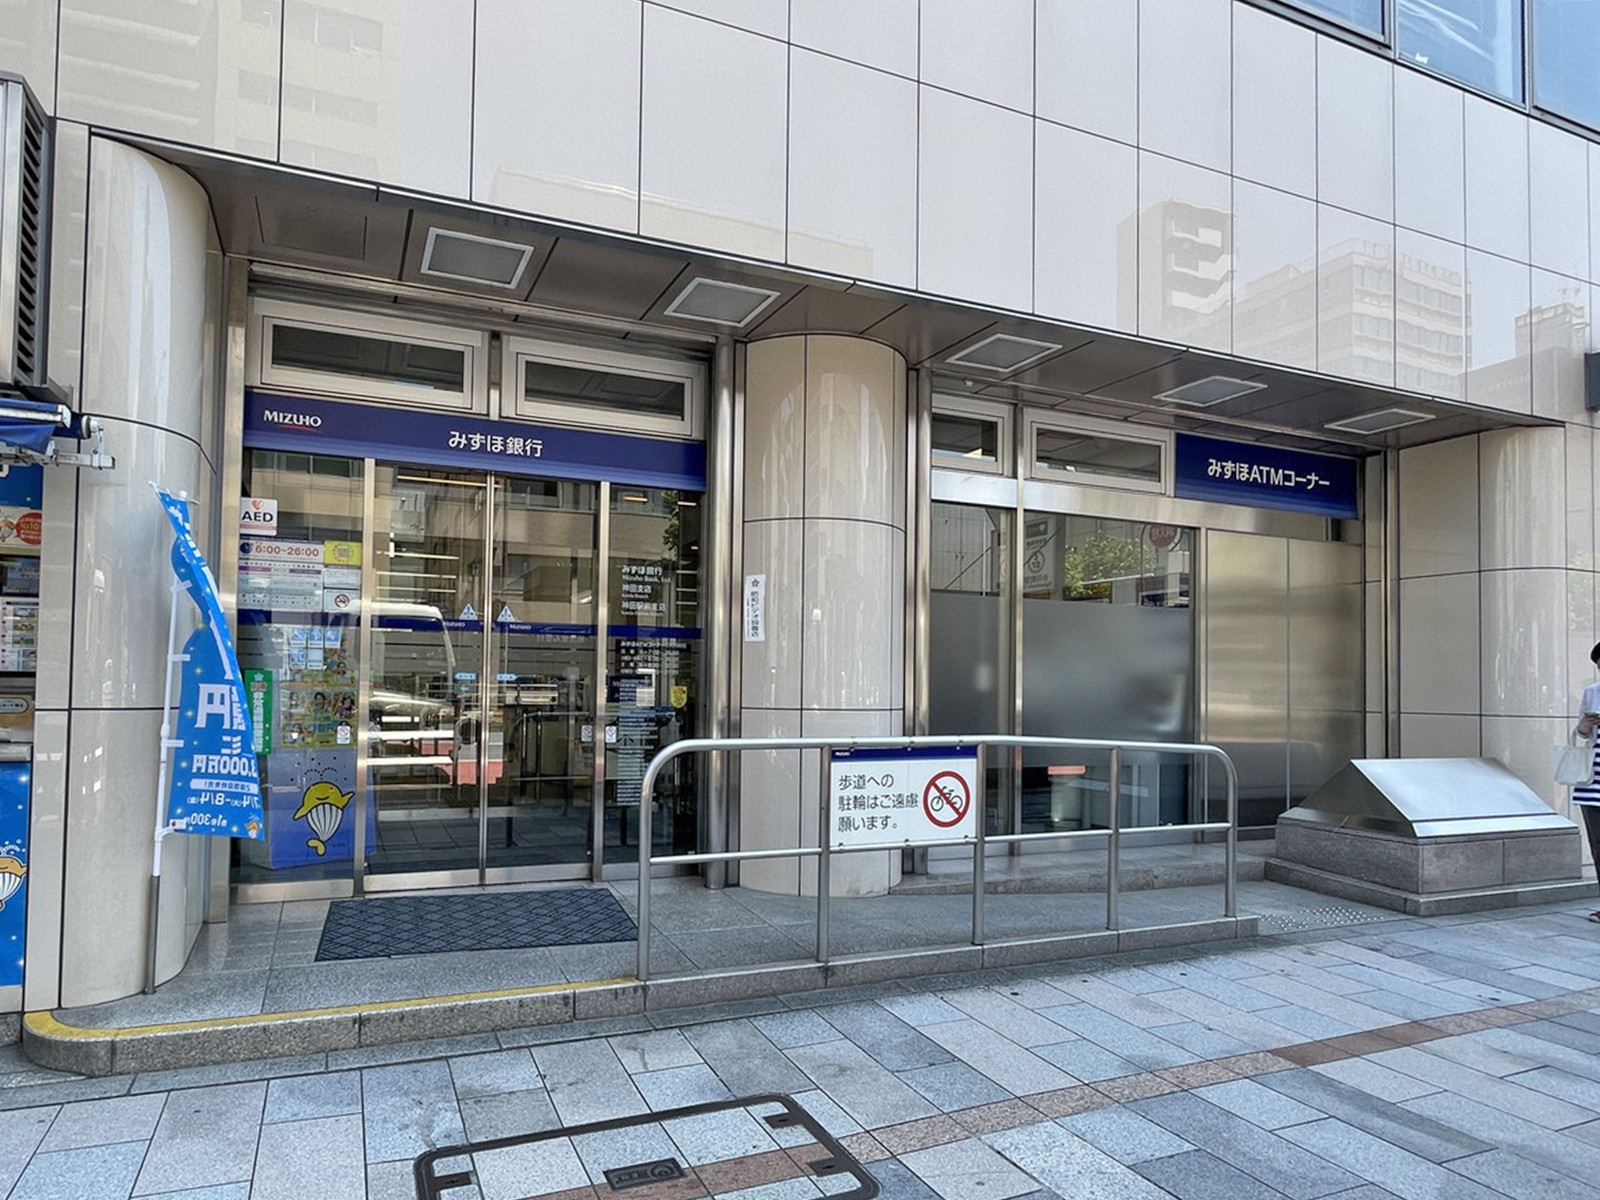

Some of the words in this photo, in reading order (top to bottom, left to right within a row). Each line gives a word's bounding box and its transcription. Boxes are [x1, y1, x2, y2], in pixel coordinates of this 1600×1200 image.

[263, 409, 322, 429] MIZUHO
[448, 431, 543, 458] みずほ銀行
[1207, 458, 1331, 489] みずほATMコーナー
[241, 510, 273, 523] AED
[621, 565, 663, 576] みずほ銀行
[838, 773, 894, 791] 歩道への
[838, 793, 919, 811] 駐輪はご遠慮
[838, 814, 898, 832] 願います。
